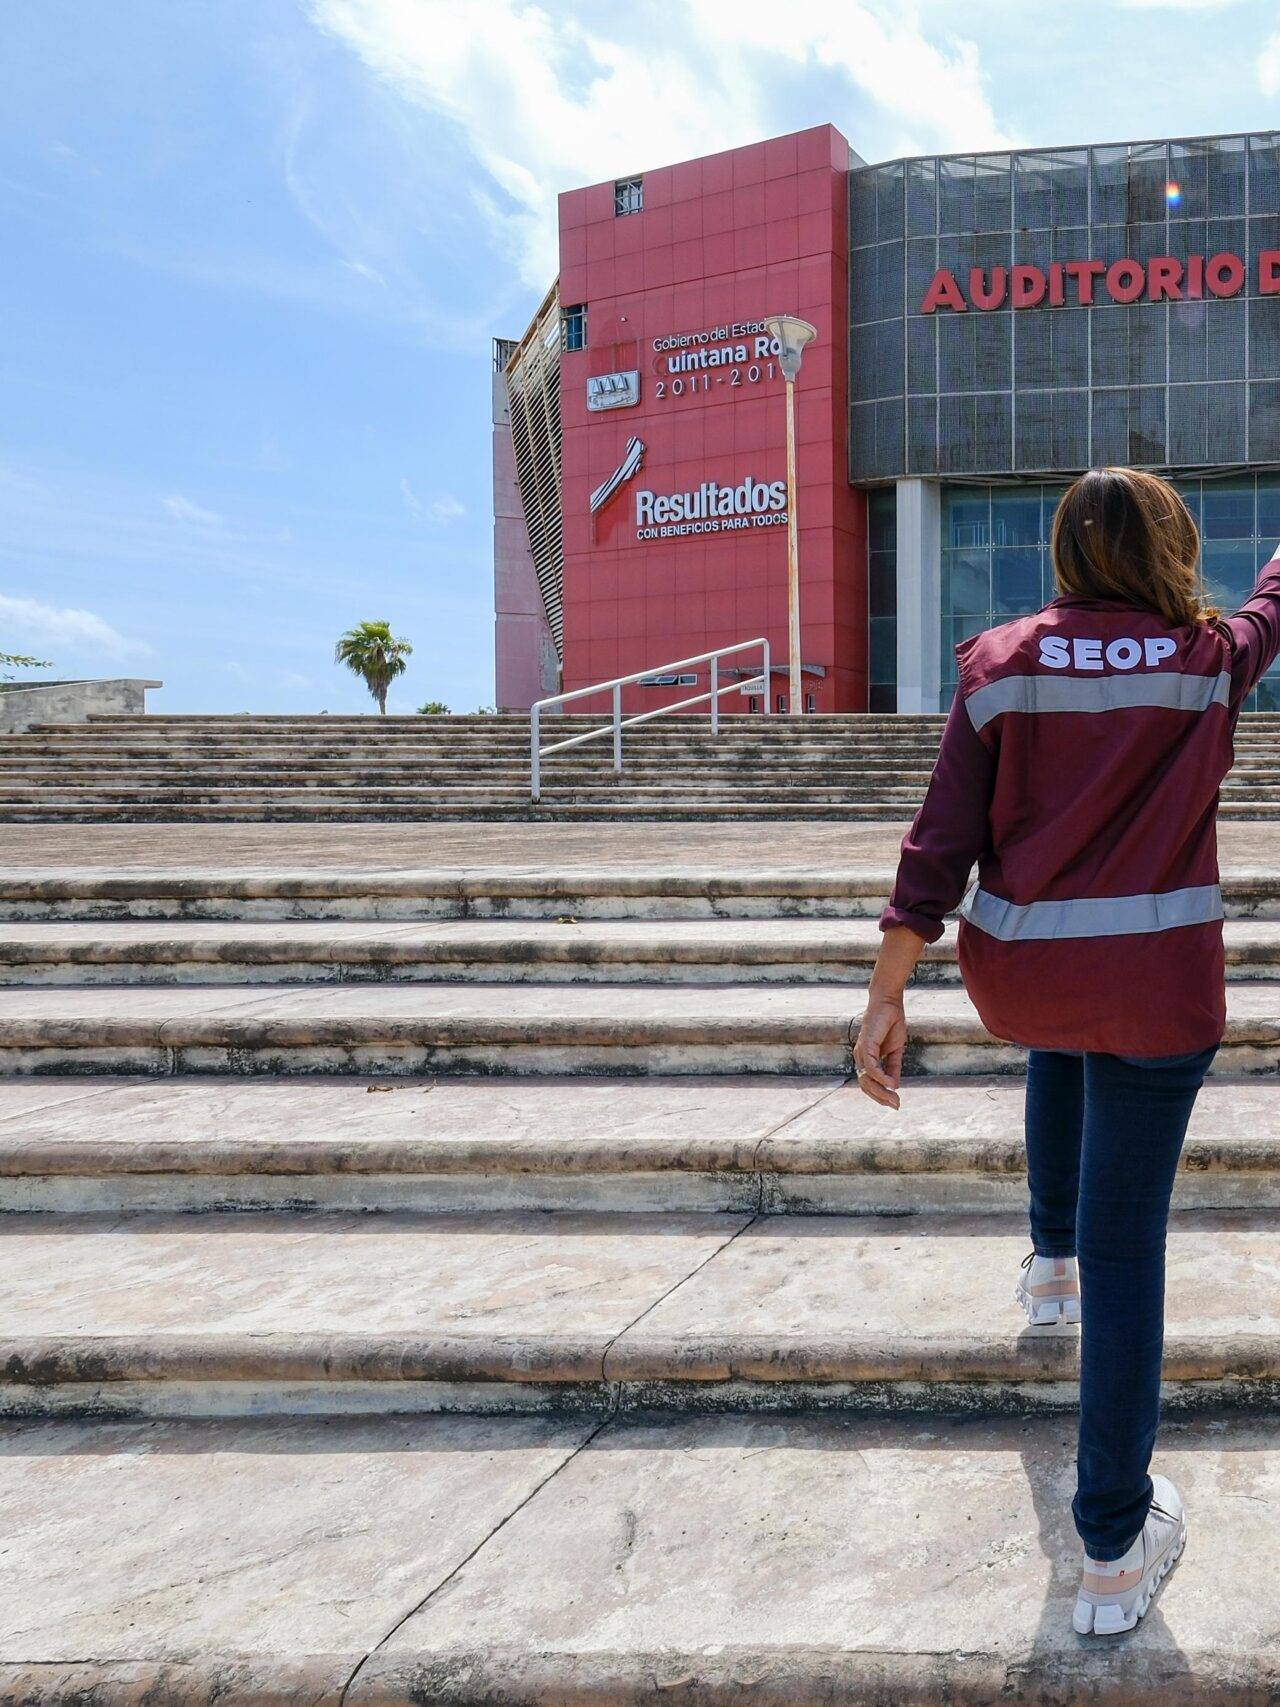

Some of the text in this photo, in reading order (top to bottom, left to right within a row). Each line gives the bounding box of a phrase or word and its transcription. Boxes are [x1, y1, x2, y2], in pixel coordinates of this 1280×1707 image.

[921, 252, 1245, 313] AUDITORIO
[653, 331, 709, 352] Gobierno
[710, 325, 728, 341] del
[755, 336, 784, 359] Ro
[656, 363, 776, 399] 2011-201
[636, 477, 787, 526] Resultados
[637, 512, 788, 540] CON BENEFICIOS PARA TODOS
[1038, 635, 1177, 670] SEOP
